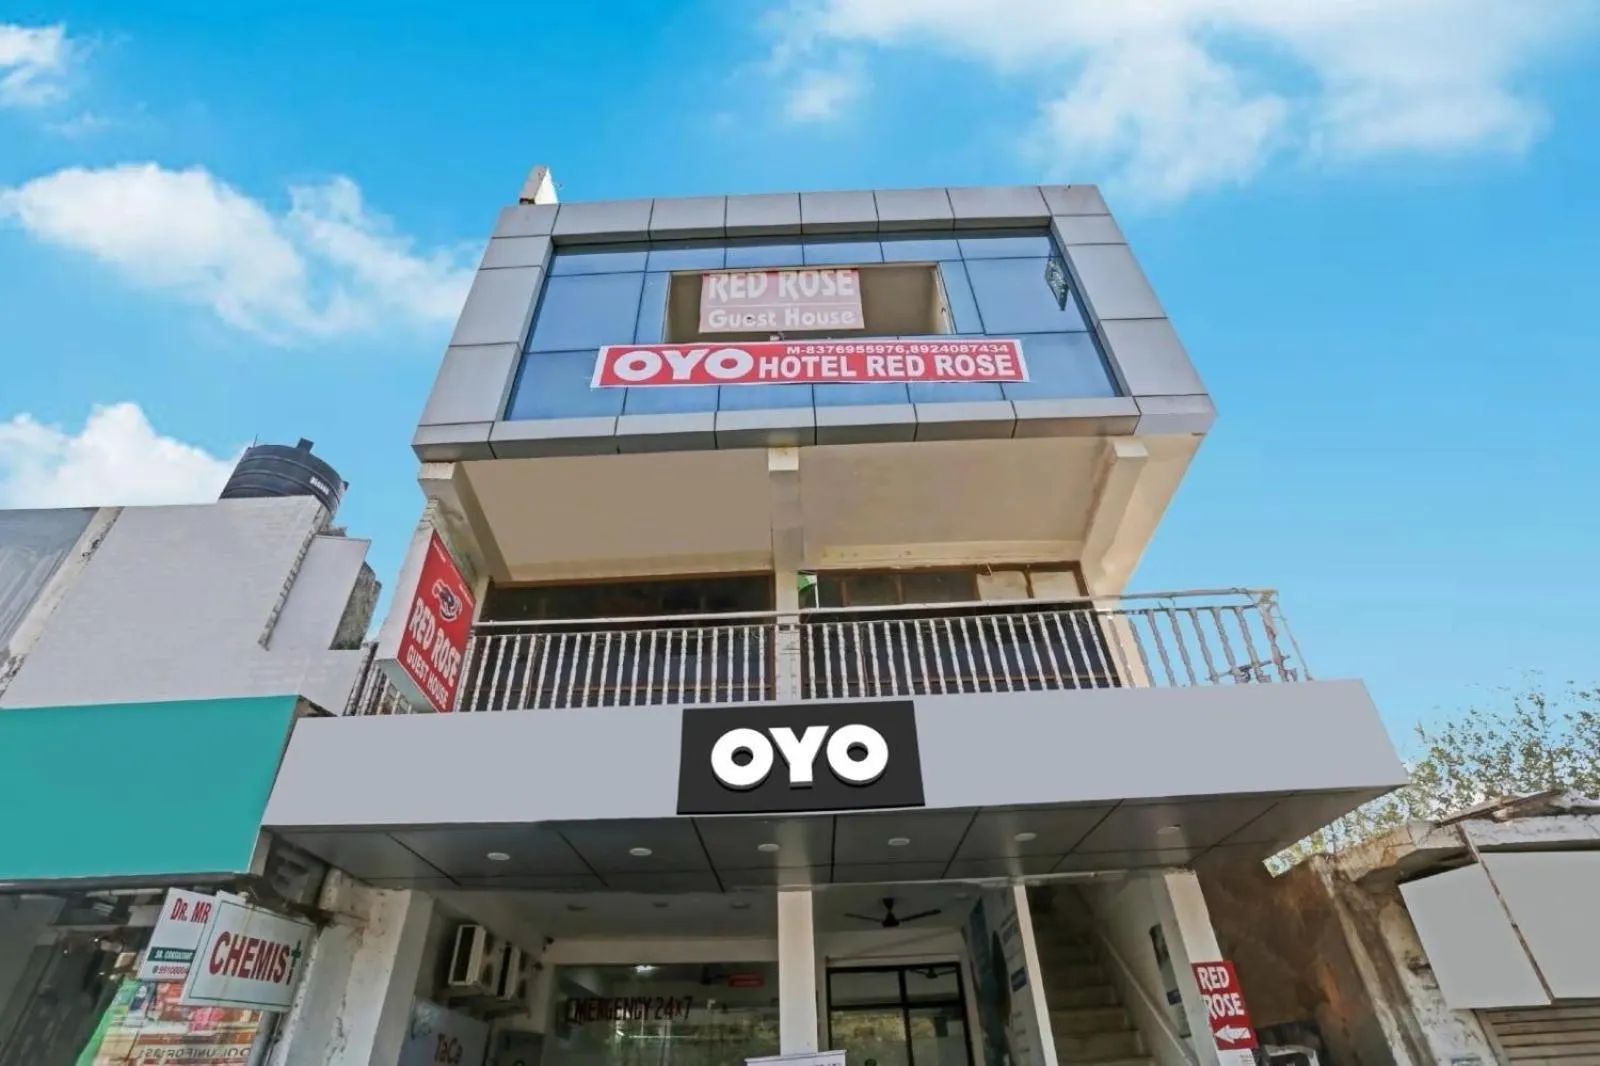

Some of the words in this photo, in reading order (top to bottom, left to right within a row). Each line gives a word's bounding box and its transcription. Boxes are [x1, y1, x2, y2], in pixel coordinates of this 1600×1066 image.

[709, 272, 768, 302] RED
[779, 270, 855, 300] ROSE
[708, 309, 776, 328] Guest
[784, 304, 857, 327] House
[613, 348, 753, 381] OYO
[758, 355, 857, 378] HOTEL
[866, 355, 925, 377] RED
[934, 354, 1016, 377] ROSE
[408, 596, 436, 650] RED
[431, 627, 462, 687] ROSE
[406, 644, 430, 682] GUEST
[427, 671, 449, 710] HOUSE
[710, 723, 889, 790] OYO
[1197, 965, 1230, 992] RED
